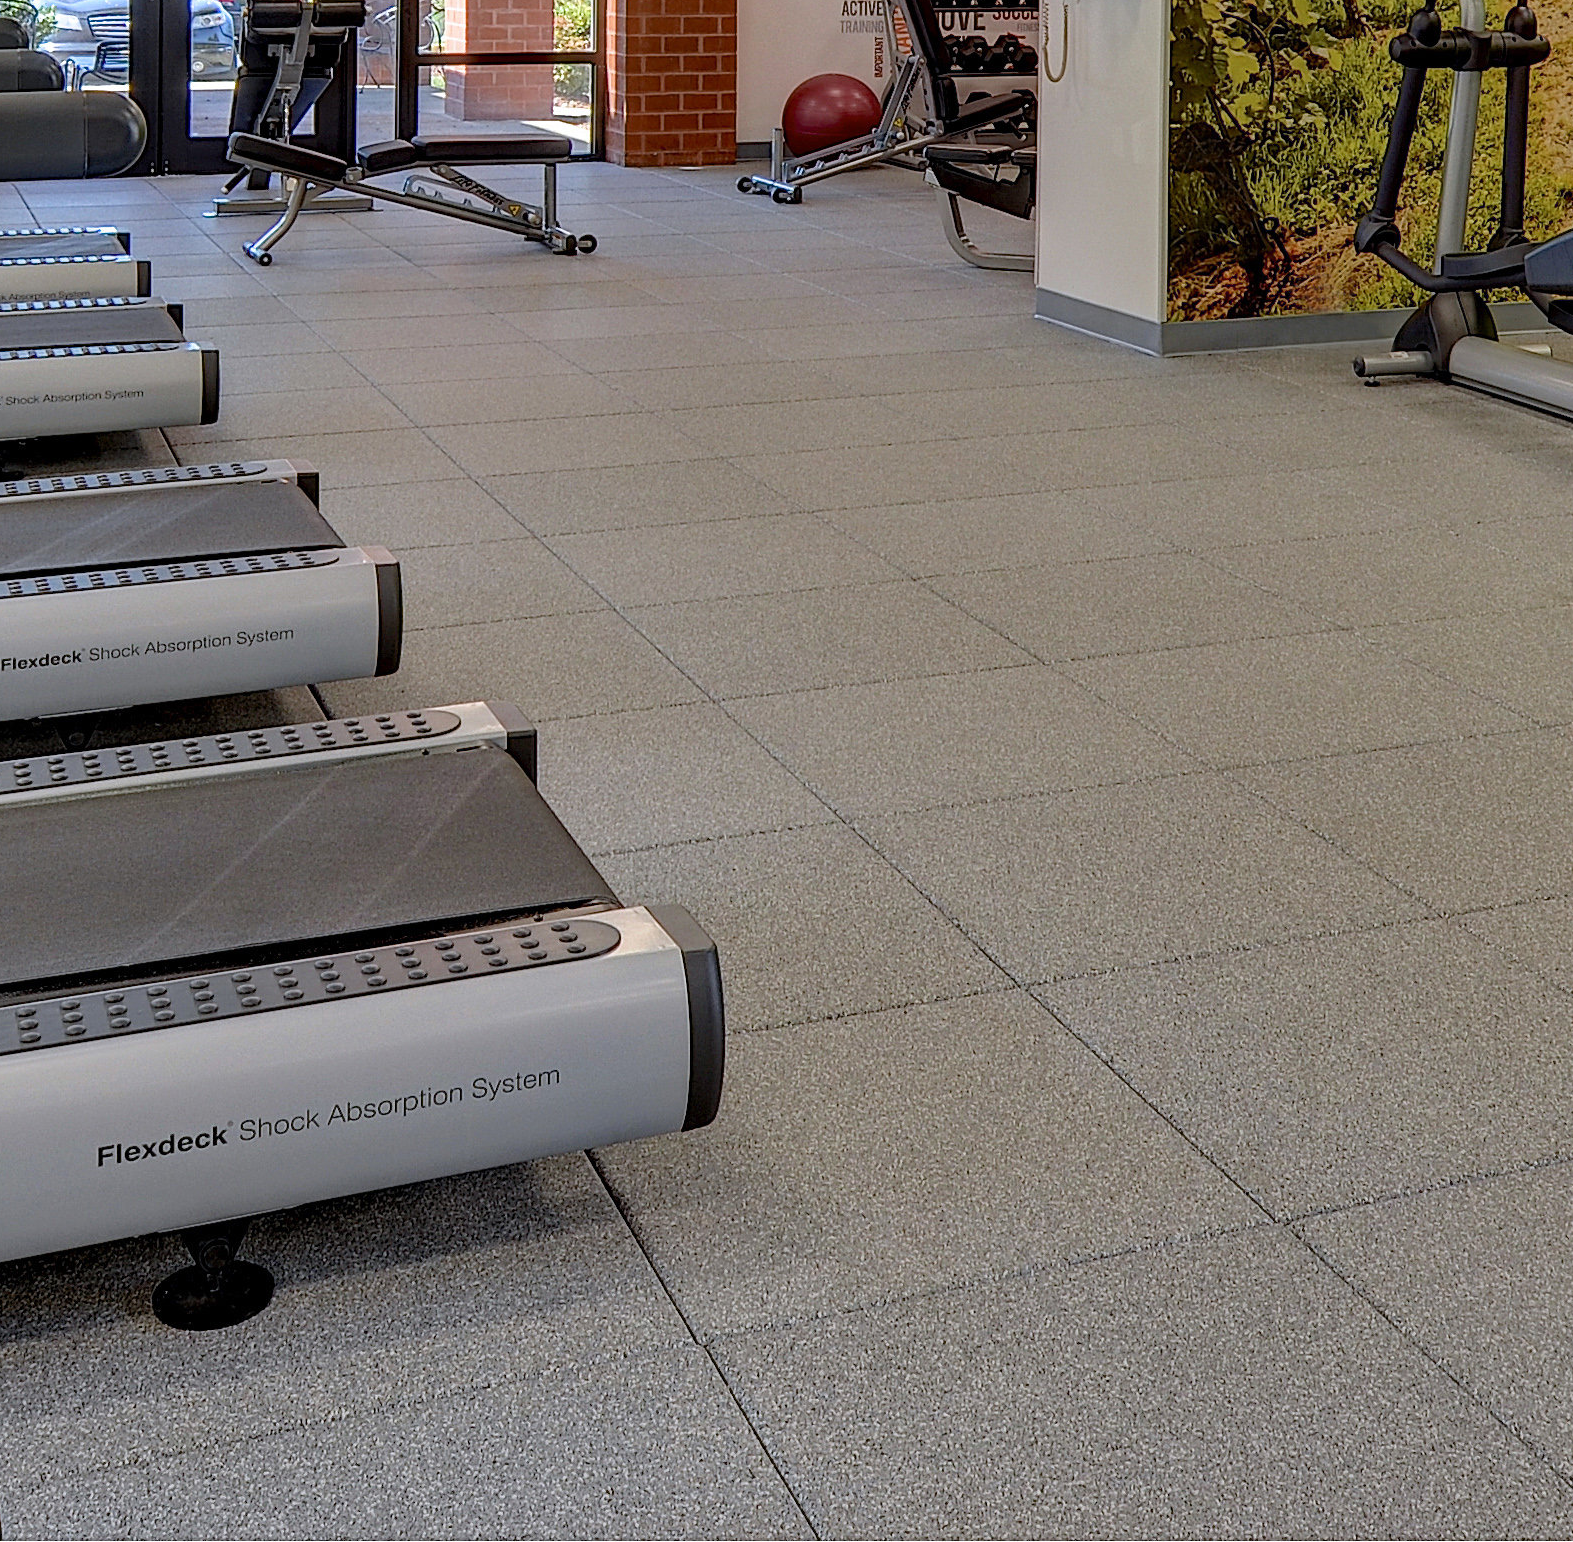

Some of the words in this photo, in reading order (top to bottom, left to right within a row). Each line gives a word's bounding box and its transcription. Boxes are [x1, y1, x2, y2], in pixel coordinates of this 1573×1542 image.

[841, 0, 883, 16] ACTIVE
[840, 20, 884, 34] TRAINING
[5, 394, 41, 406] Shock
[43, 391, 102, 403] Absorption
[104, 389, 144, 401] System
[0, 649, 82, 672] Flexdeck
[88, 643, 141, 662] Shock
[144, 634, 232, 655] Absorption
[236, 628, 295, 647] System
[97, 1124, 229, 1167] Flexdeck
[238, 1108, 321, 1142] Shock
[327, 1083, 464, 1125] Absorption
[471, 1067, 562, 1102] System
